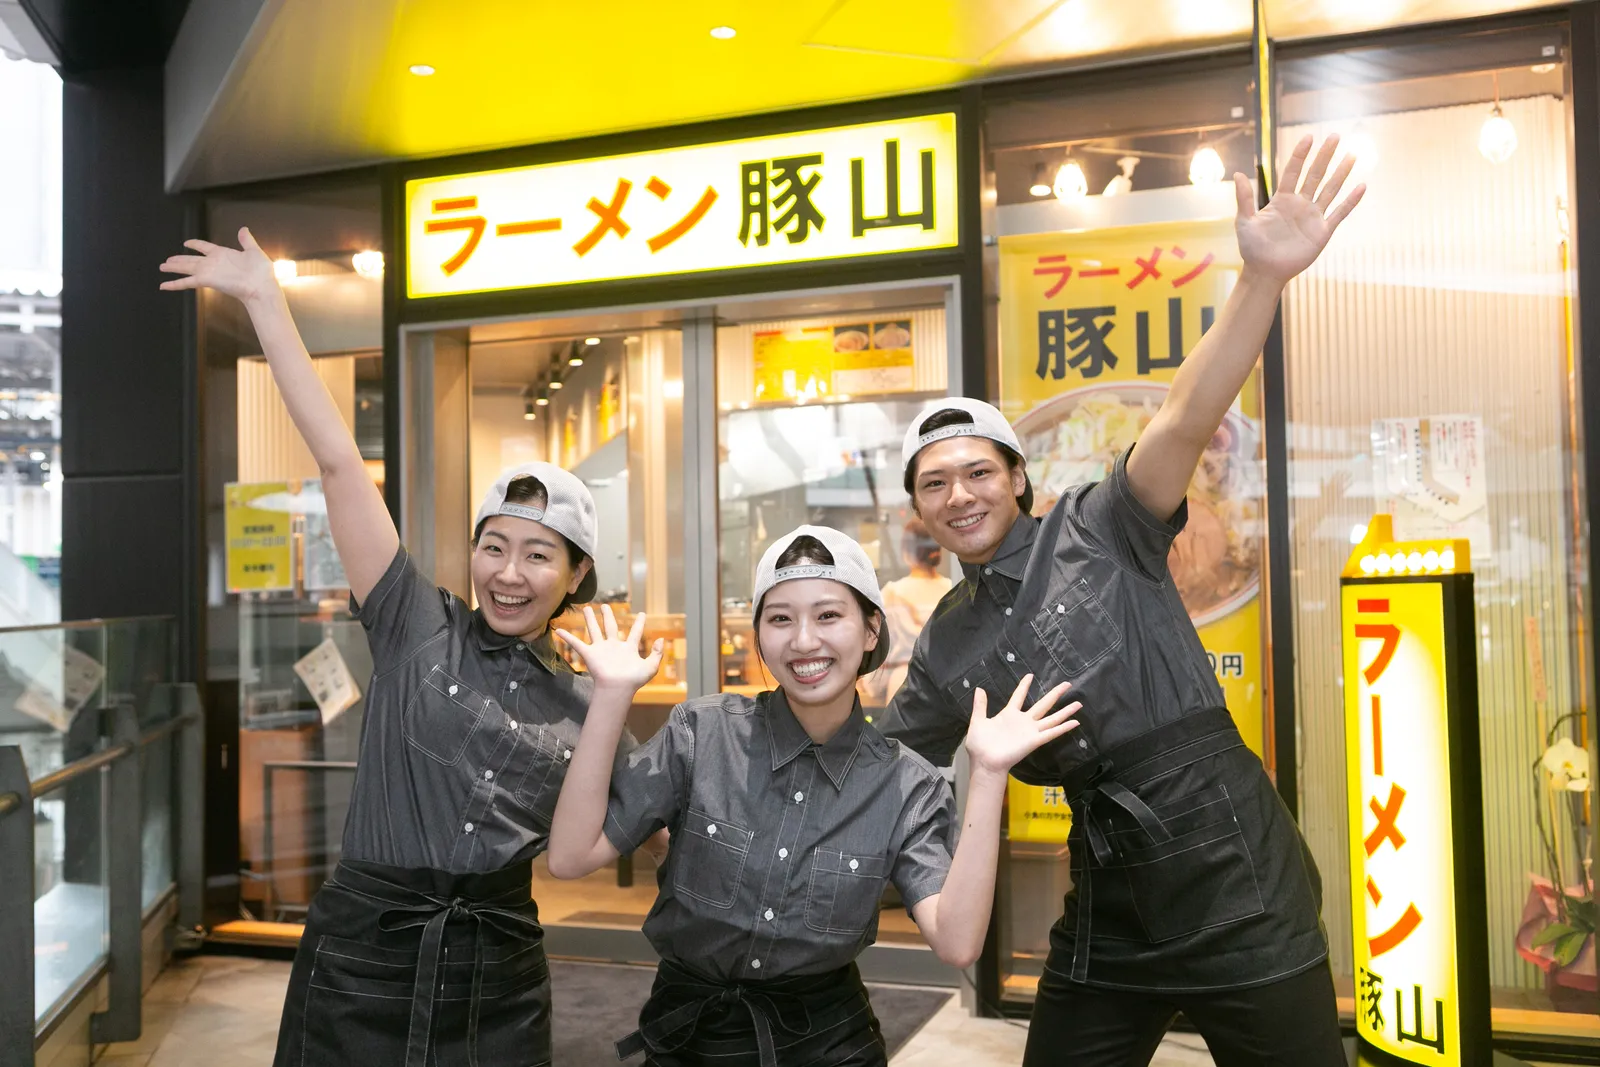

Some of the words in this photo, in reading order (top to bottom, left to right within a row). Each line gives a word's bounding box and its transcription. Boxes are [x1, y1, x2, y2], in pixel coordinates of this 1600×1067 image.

[1033, 244, 1215, 299] ラーメン
[1035, 297, 1214, 380] 豚山
[1354, 598, 1423, 959] ラーメン
[1360, 966, 1445, 1056] 豚山
